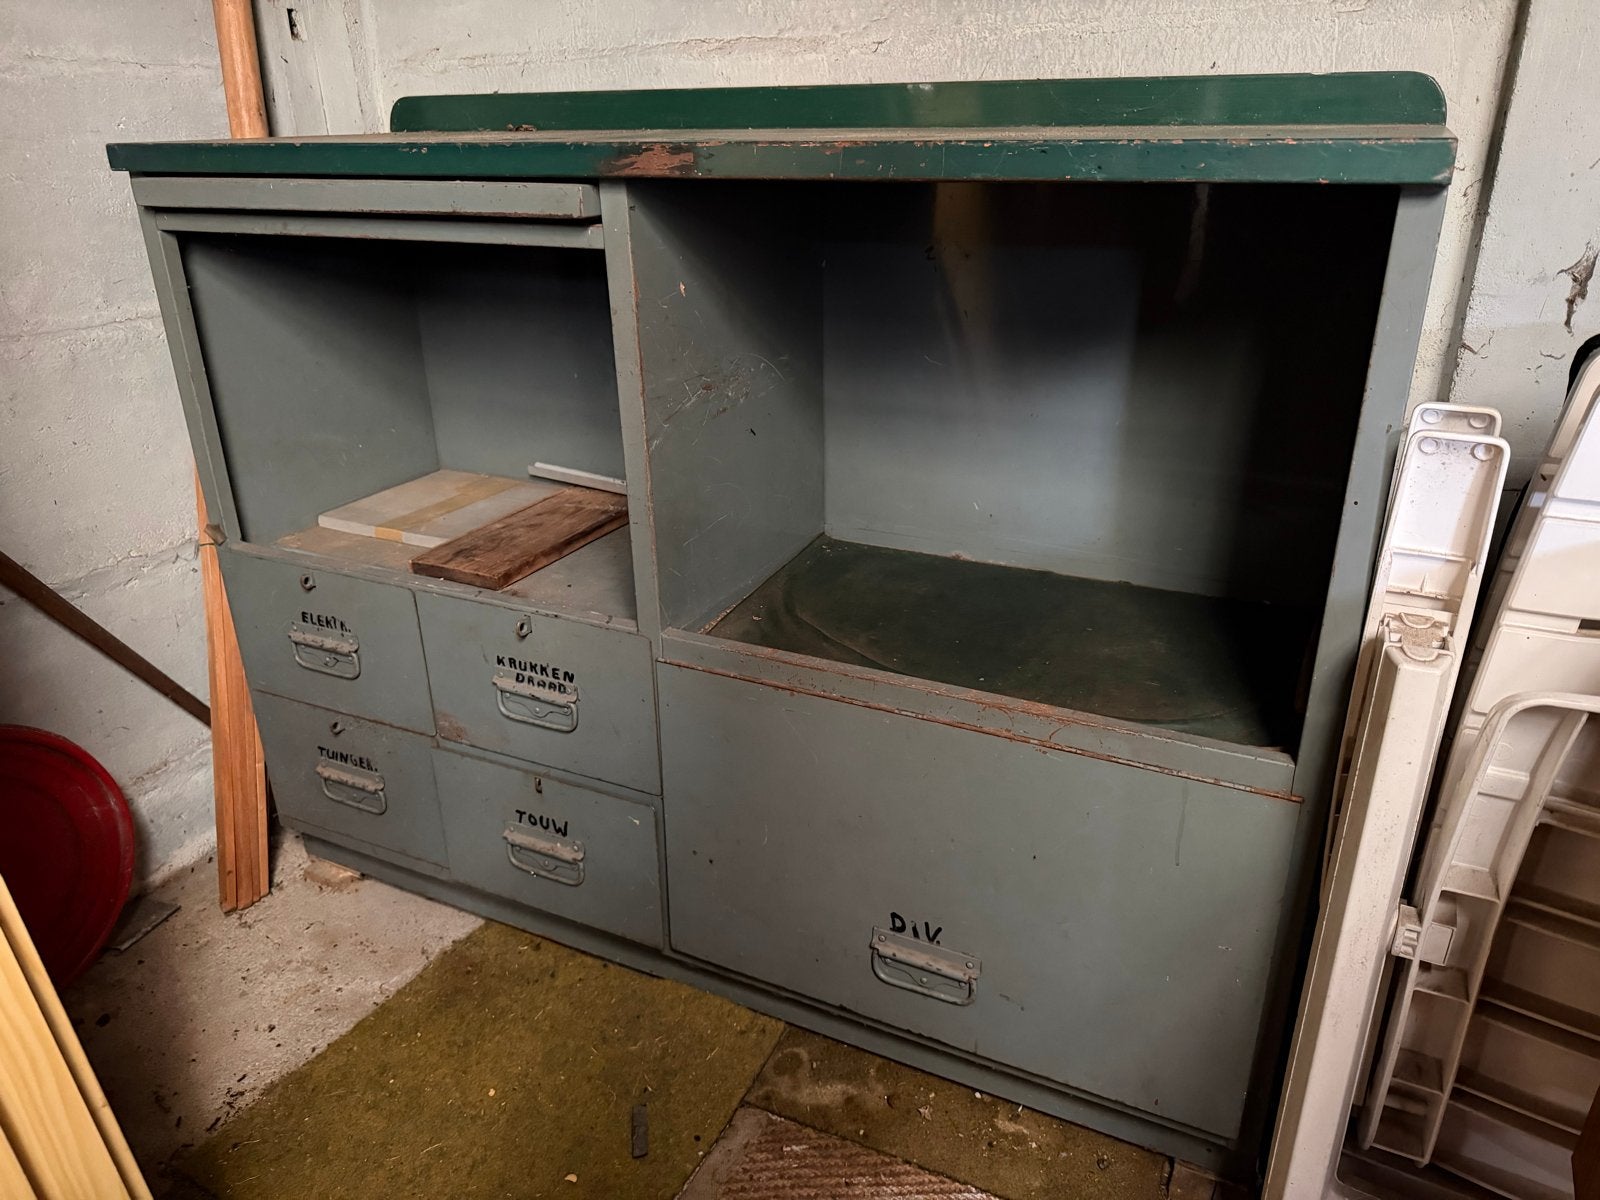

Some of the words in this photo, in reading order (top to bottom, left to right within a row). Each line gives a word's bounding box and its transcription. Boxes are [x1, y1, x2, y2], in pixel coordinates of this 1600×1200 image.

[496, 655, 575, 683] KRUKKEN
[515, 672, 567, 694] DRAAD
[515, 809, 569, 838] TOUW
